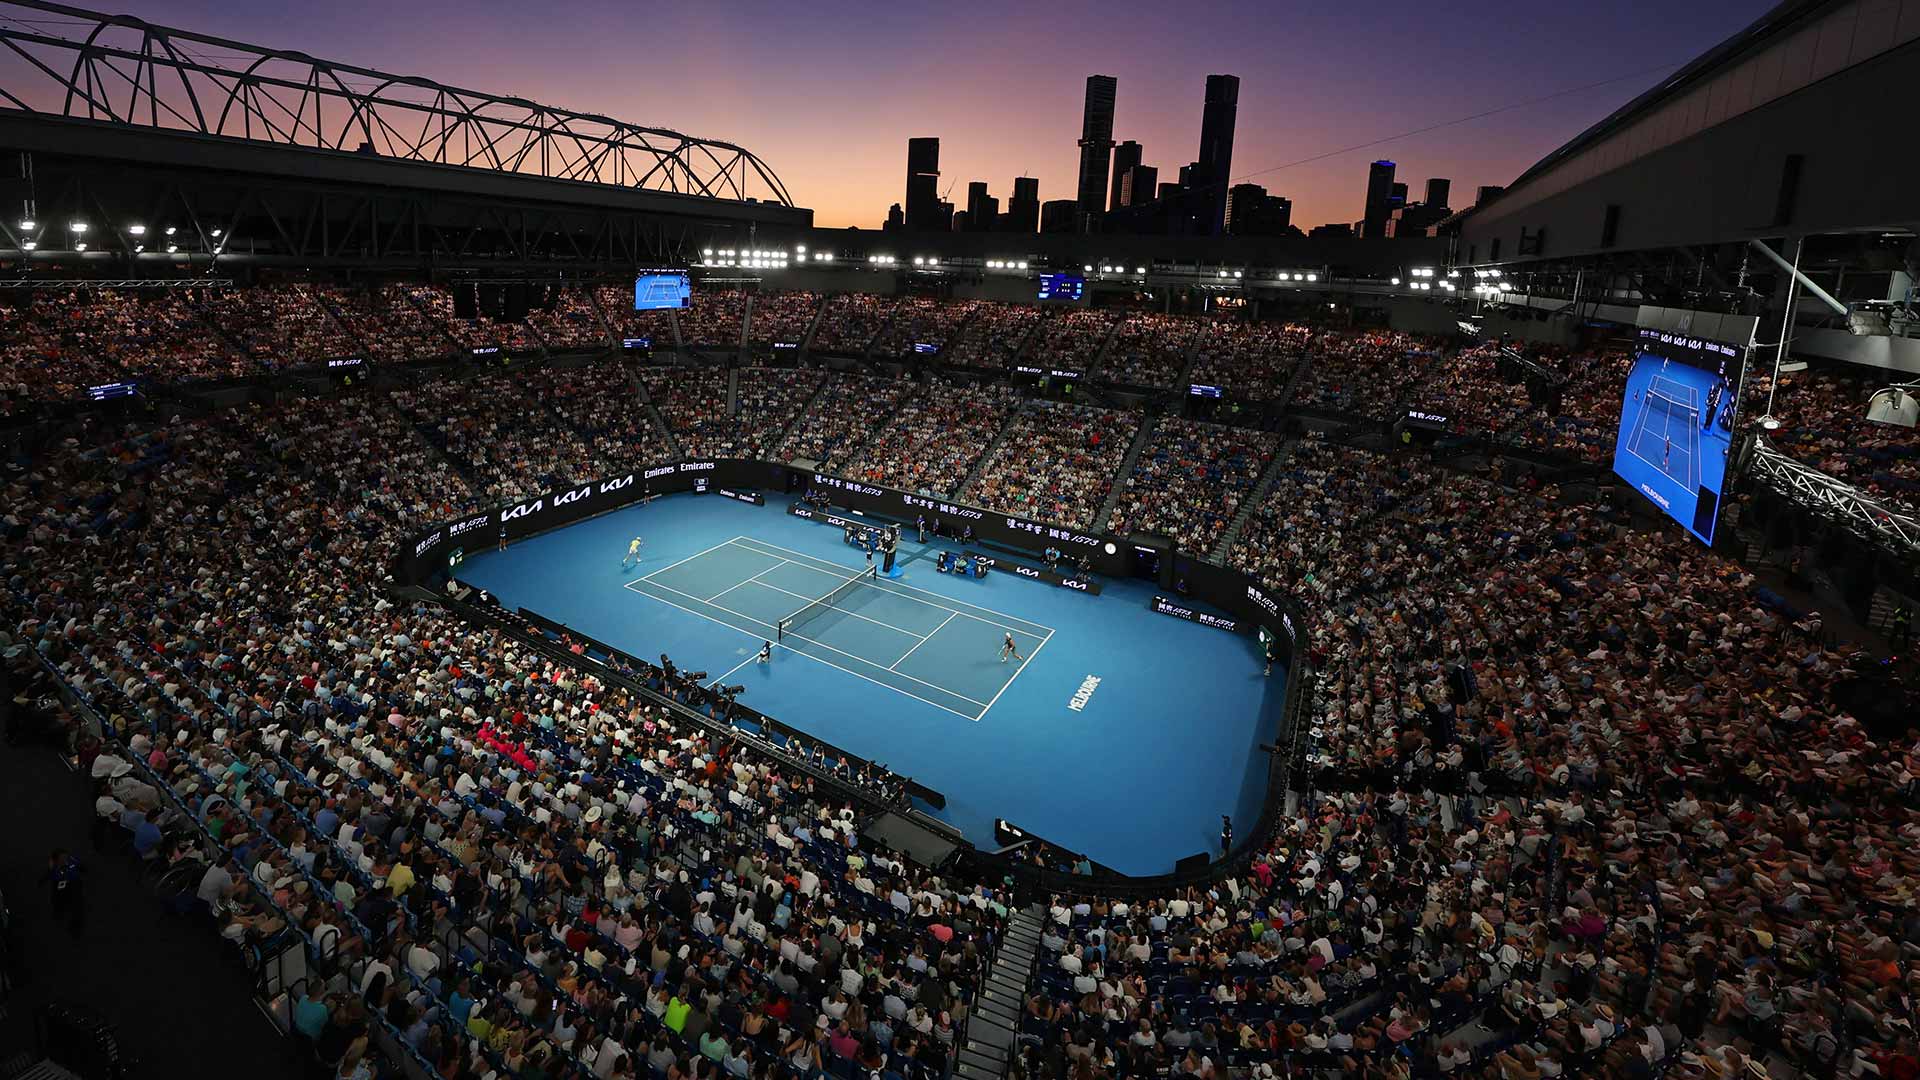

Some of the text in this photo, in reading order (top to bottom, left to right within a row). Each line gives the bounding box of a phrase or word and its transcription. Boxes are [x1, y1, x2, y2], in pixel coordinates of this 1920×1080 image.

[645, 462, 715, 478] Emirates Emirates
[501, 475, 633, 522] KIA KIA KIA
[1016, 566, 1087, 591] KIA KIA
[1067, 674, 1102, 712] MELBOURNE
